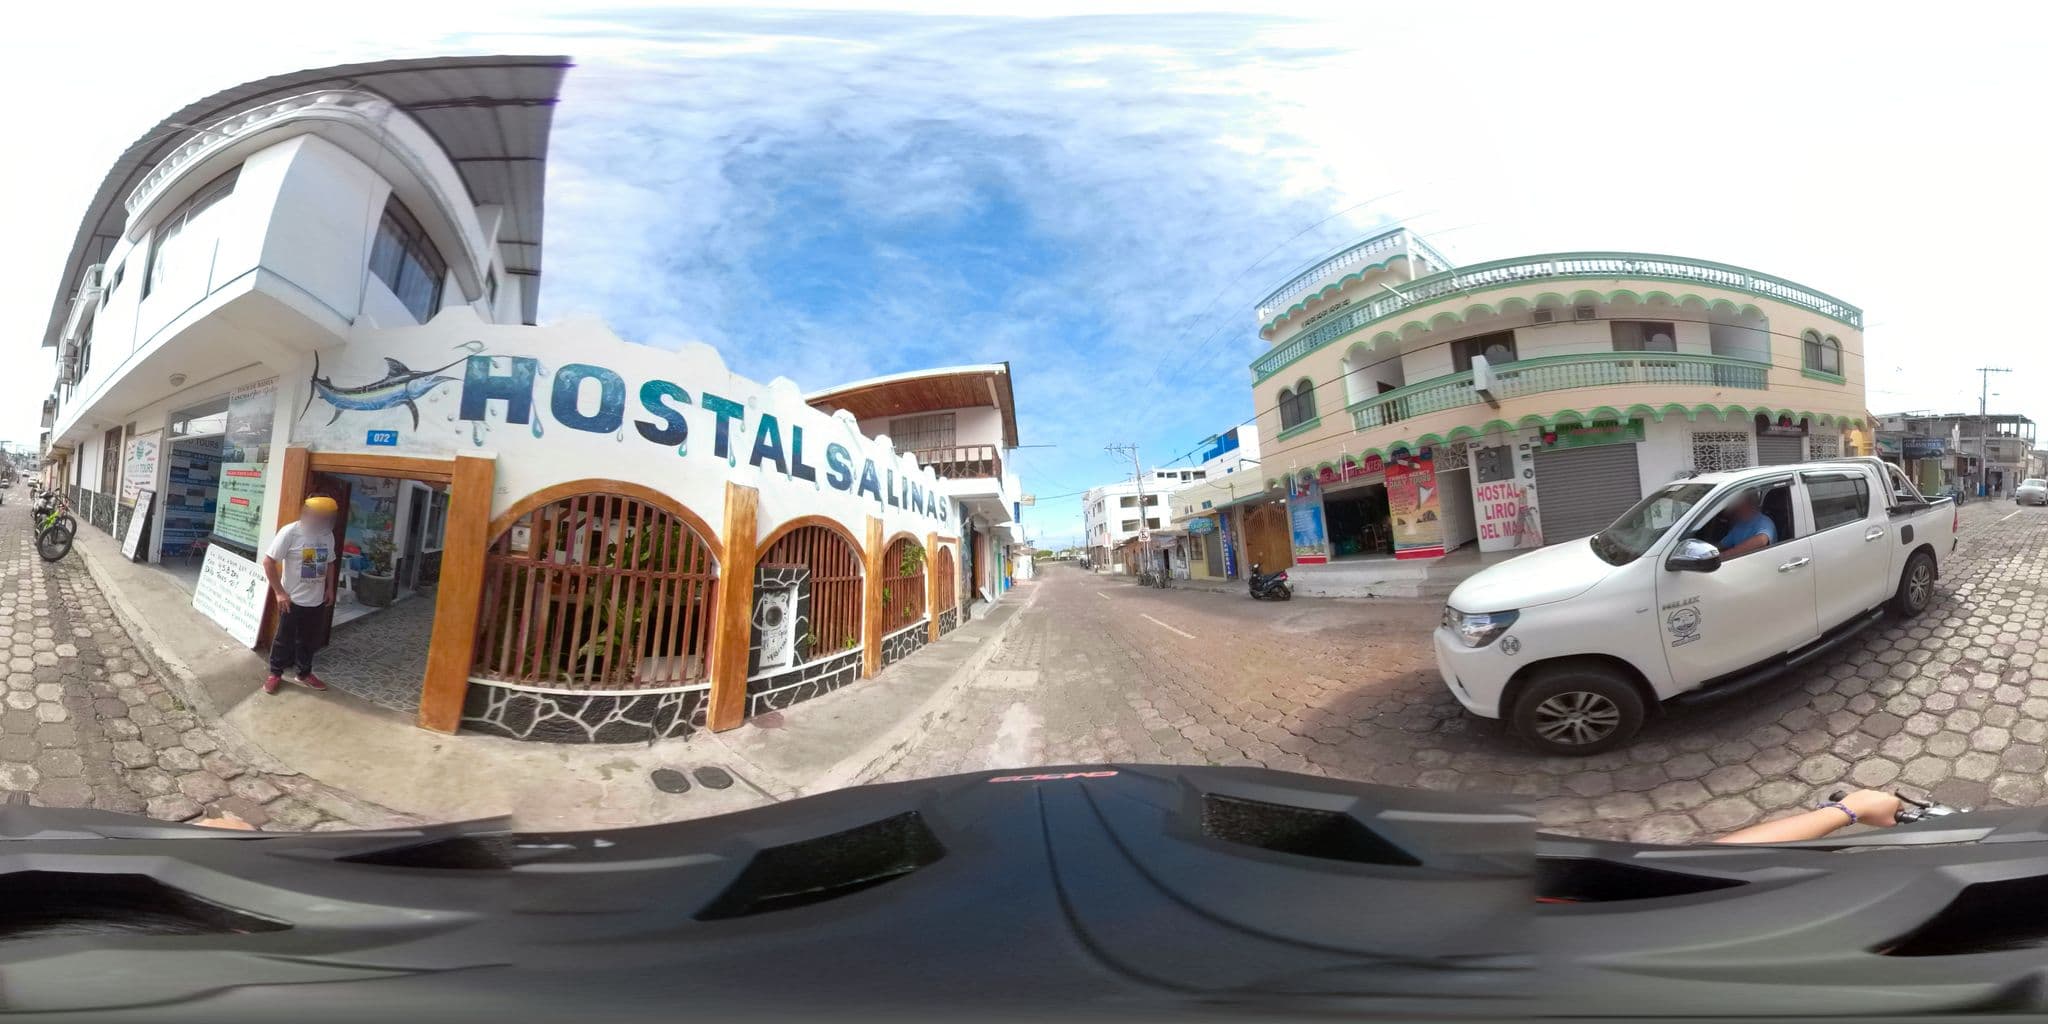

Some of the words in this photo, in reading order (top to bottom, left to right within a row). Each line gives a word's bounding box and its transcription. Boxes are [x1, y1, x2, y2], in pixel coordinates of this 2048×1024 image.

[373, 433, 391, 443] 072
[460, 355, 816, 482] HOSTAL
[826, 442, 947, 522] SALINAS
[1476, 483, 1520, 501] HOSTAL
[1484, 502, 1516, 520] LIRIO
[1480, 523, 1500, 540] DEL
